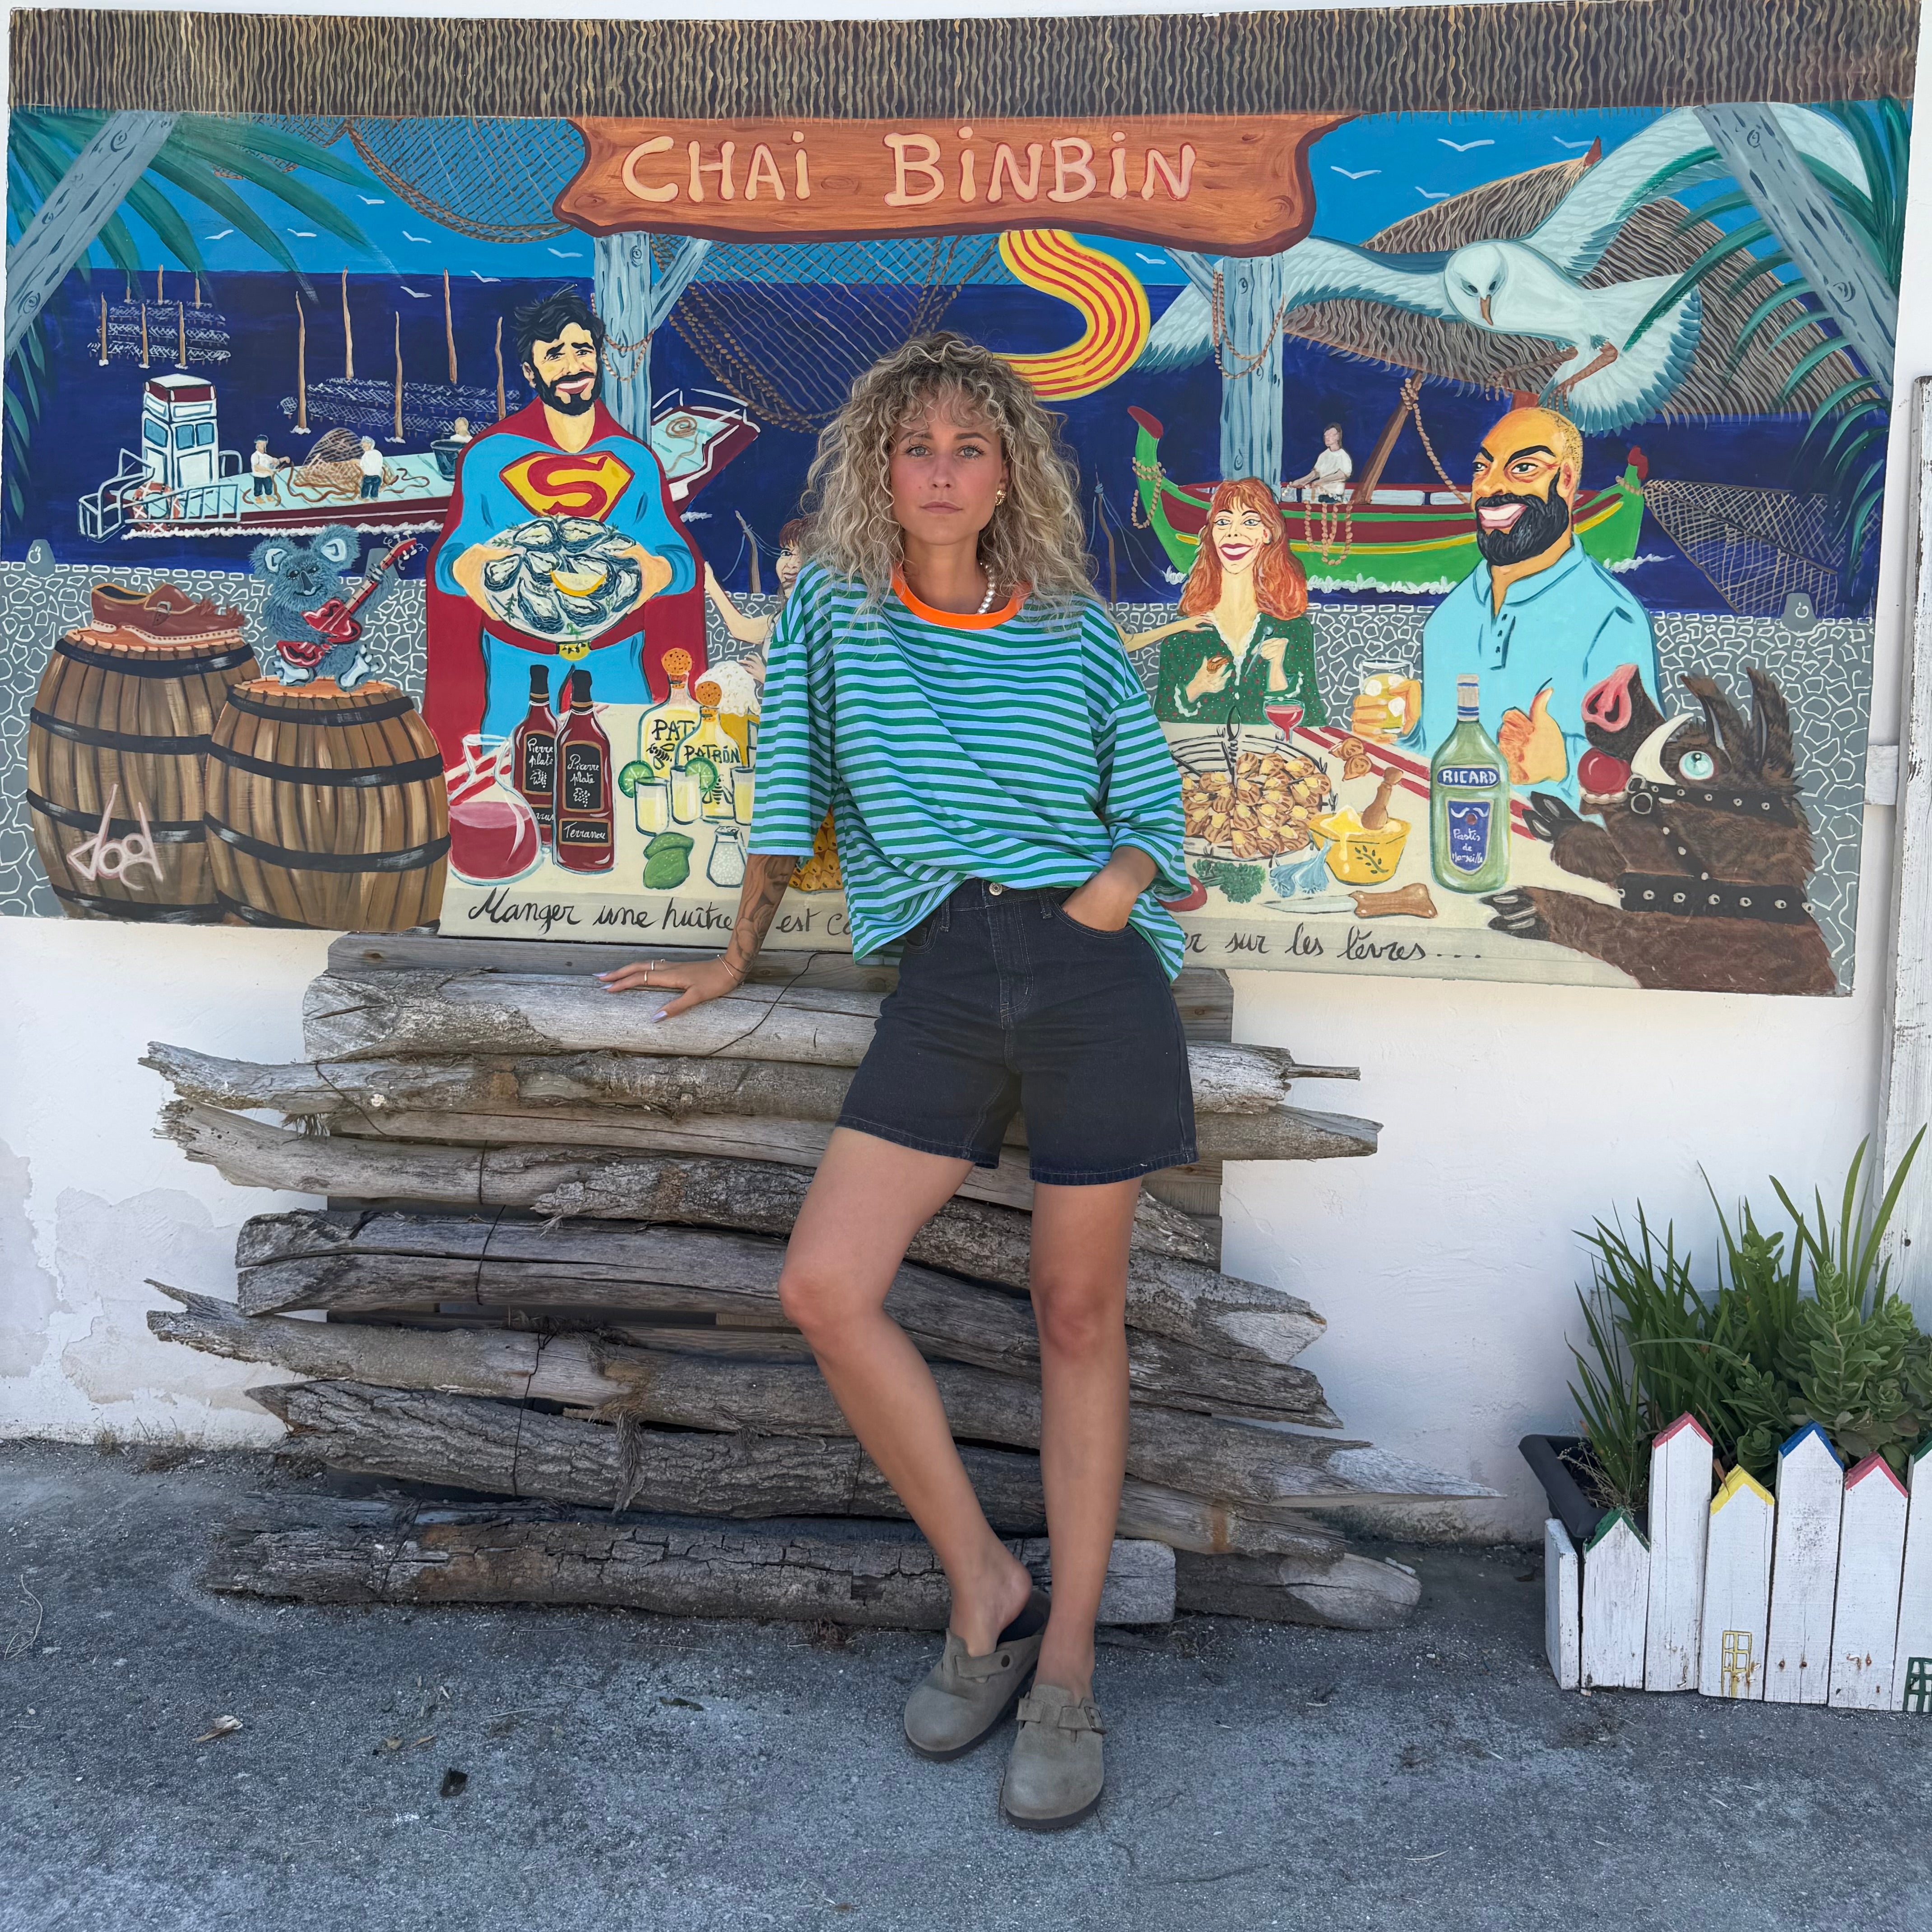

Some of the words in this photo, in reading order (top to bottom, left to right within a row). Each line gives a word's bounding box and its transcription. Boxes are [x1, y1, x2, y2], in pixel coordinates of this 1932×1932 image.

[529, 753, 553, 767] plate
[570, 771, 595, 786] plate
[1443, 770, 1497, 784] RICARD
[1453, 828, 1481, 841] Pastis
[1462, 843, 1472, 852] de
[468, 887, 583, 937] Manger
[592, 905, 660, 929] une
[662, 897, 734, 931] huître
[1225, 932, 1271, 954] sur
[1285, 922, 1324, 957] les
